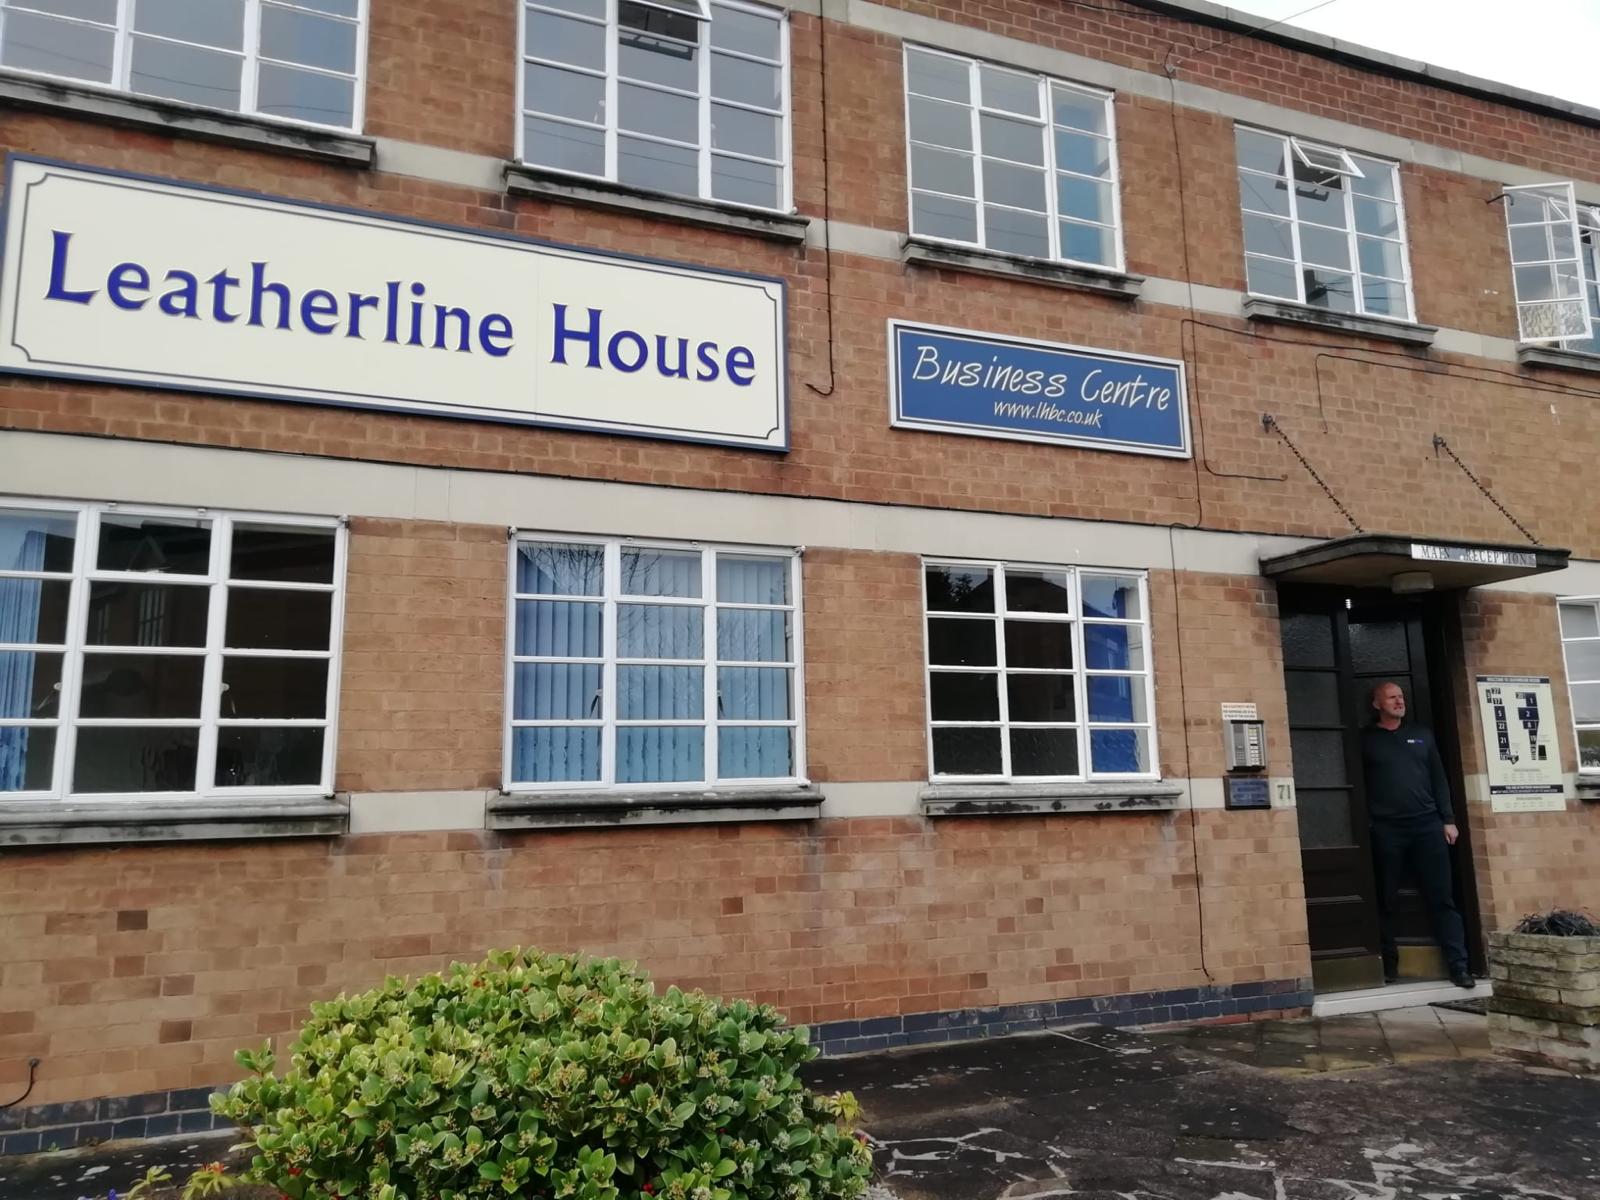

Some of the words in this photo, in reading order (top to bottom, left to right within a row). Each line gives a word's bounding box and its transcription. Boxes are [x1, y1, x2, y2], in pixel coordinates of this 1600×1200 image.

[44, 229, 515, 358] Leatherline
[548, 302, 756, 387] House
[912, 345, 1068, 397] Business
[1080, 369, 1171, 411] Centre
[993, 401, 1103, 428] www.lhbc.co.uk
[1421, 544, 1450, 559] MAIN
[1277, 784, 1291, 800] 71
